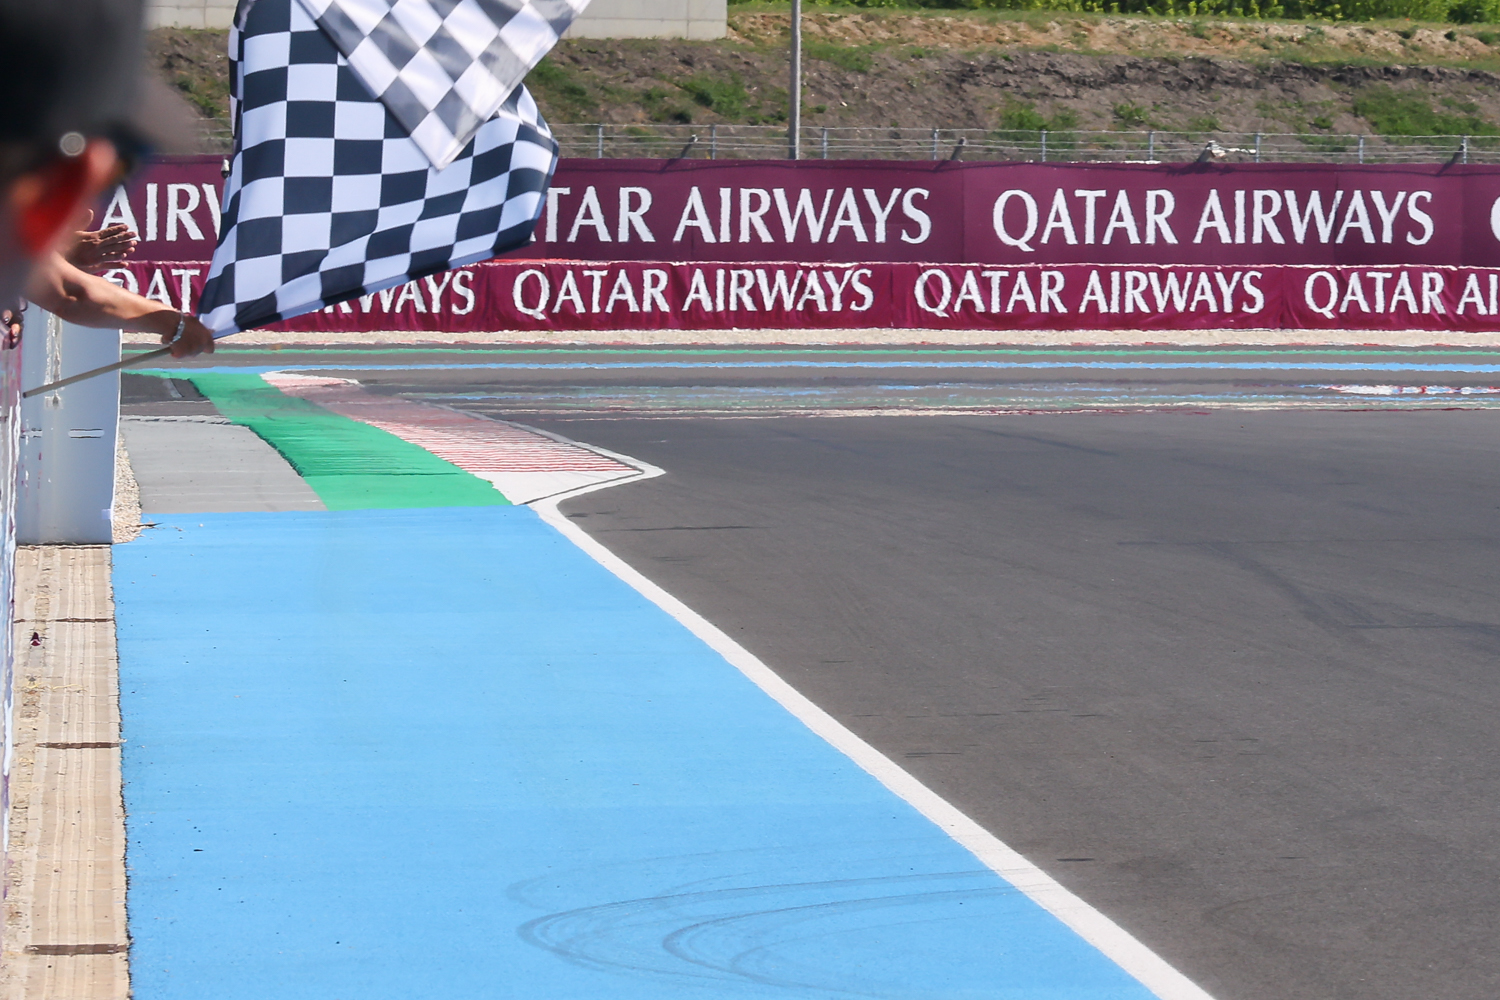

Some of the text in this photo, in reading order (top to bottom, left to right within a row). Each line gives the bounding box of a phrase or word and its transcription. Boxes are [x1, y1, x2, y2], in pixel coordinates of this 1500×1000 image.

[530, 186, 932, 244] TAR AIRWAYS
[993, 188, 1434, 251] QATAR AIRWAYS
[313, 270, 475, 315] WAYS
[513, 268, 873, 320] QATAR AIRWAYS
[914, 269, 1264, 317] QATAR AIRWAYS
[1305, 271, 1447, 319] QATAR
